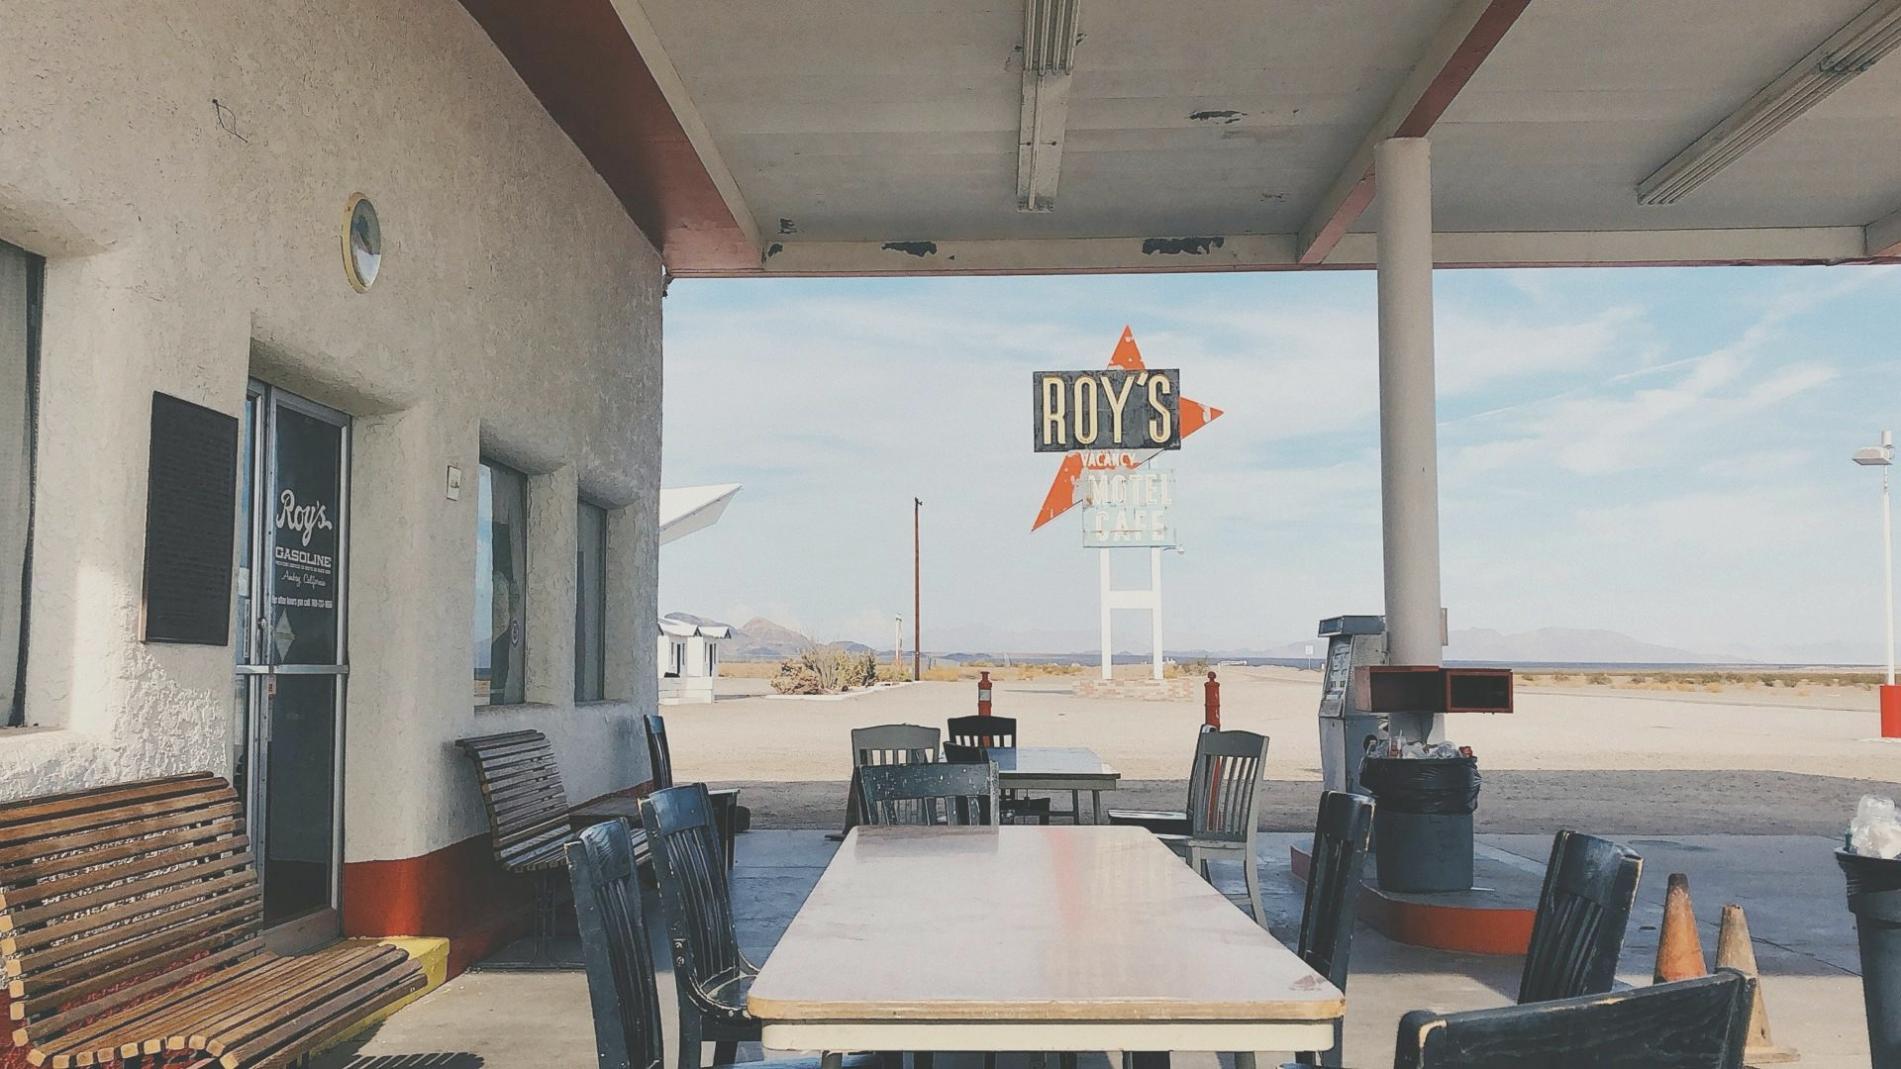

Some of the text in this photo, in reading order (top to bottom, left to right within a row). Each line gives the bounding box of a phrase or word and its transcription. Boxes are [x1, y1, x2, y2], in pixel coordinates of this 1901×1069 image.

[1042, 372, 1171, 445] ROY'S
[1081, 452, 1137, 468] VACANCY
[1087, 474, 1173, 506] MOTEL
[276, 489, 333, 547] Roy's
[1094, 511, 1166, 542] CAFE
[275, 546, 332, 568] GASOLINE
